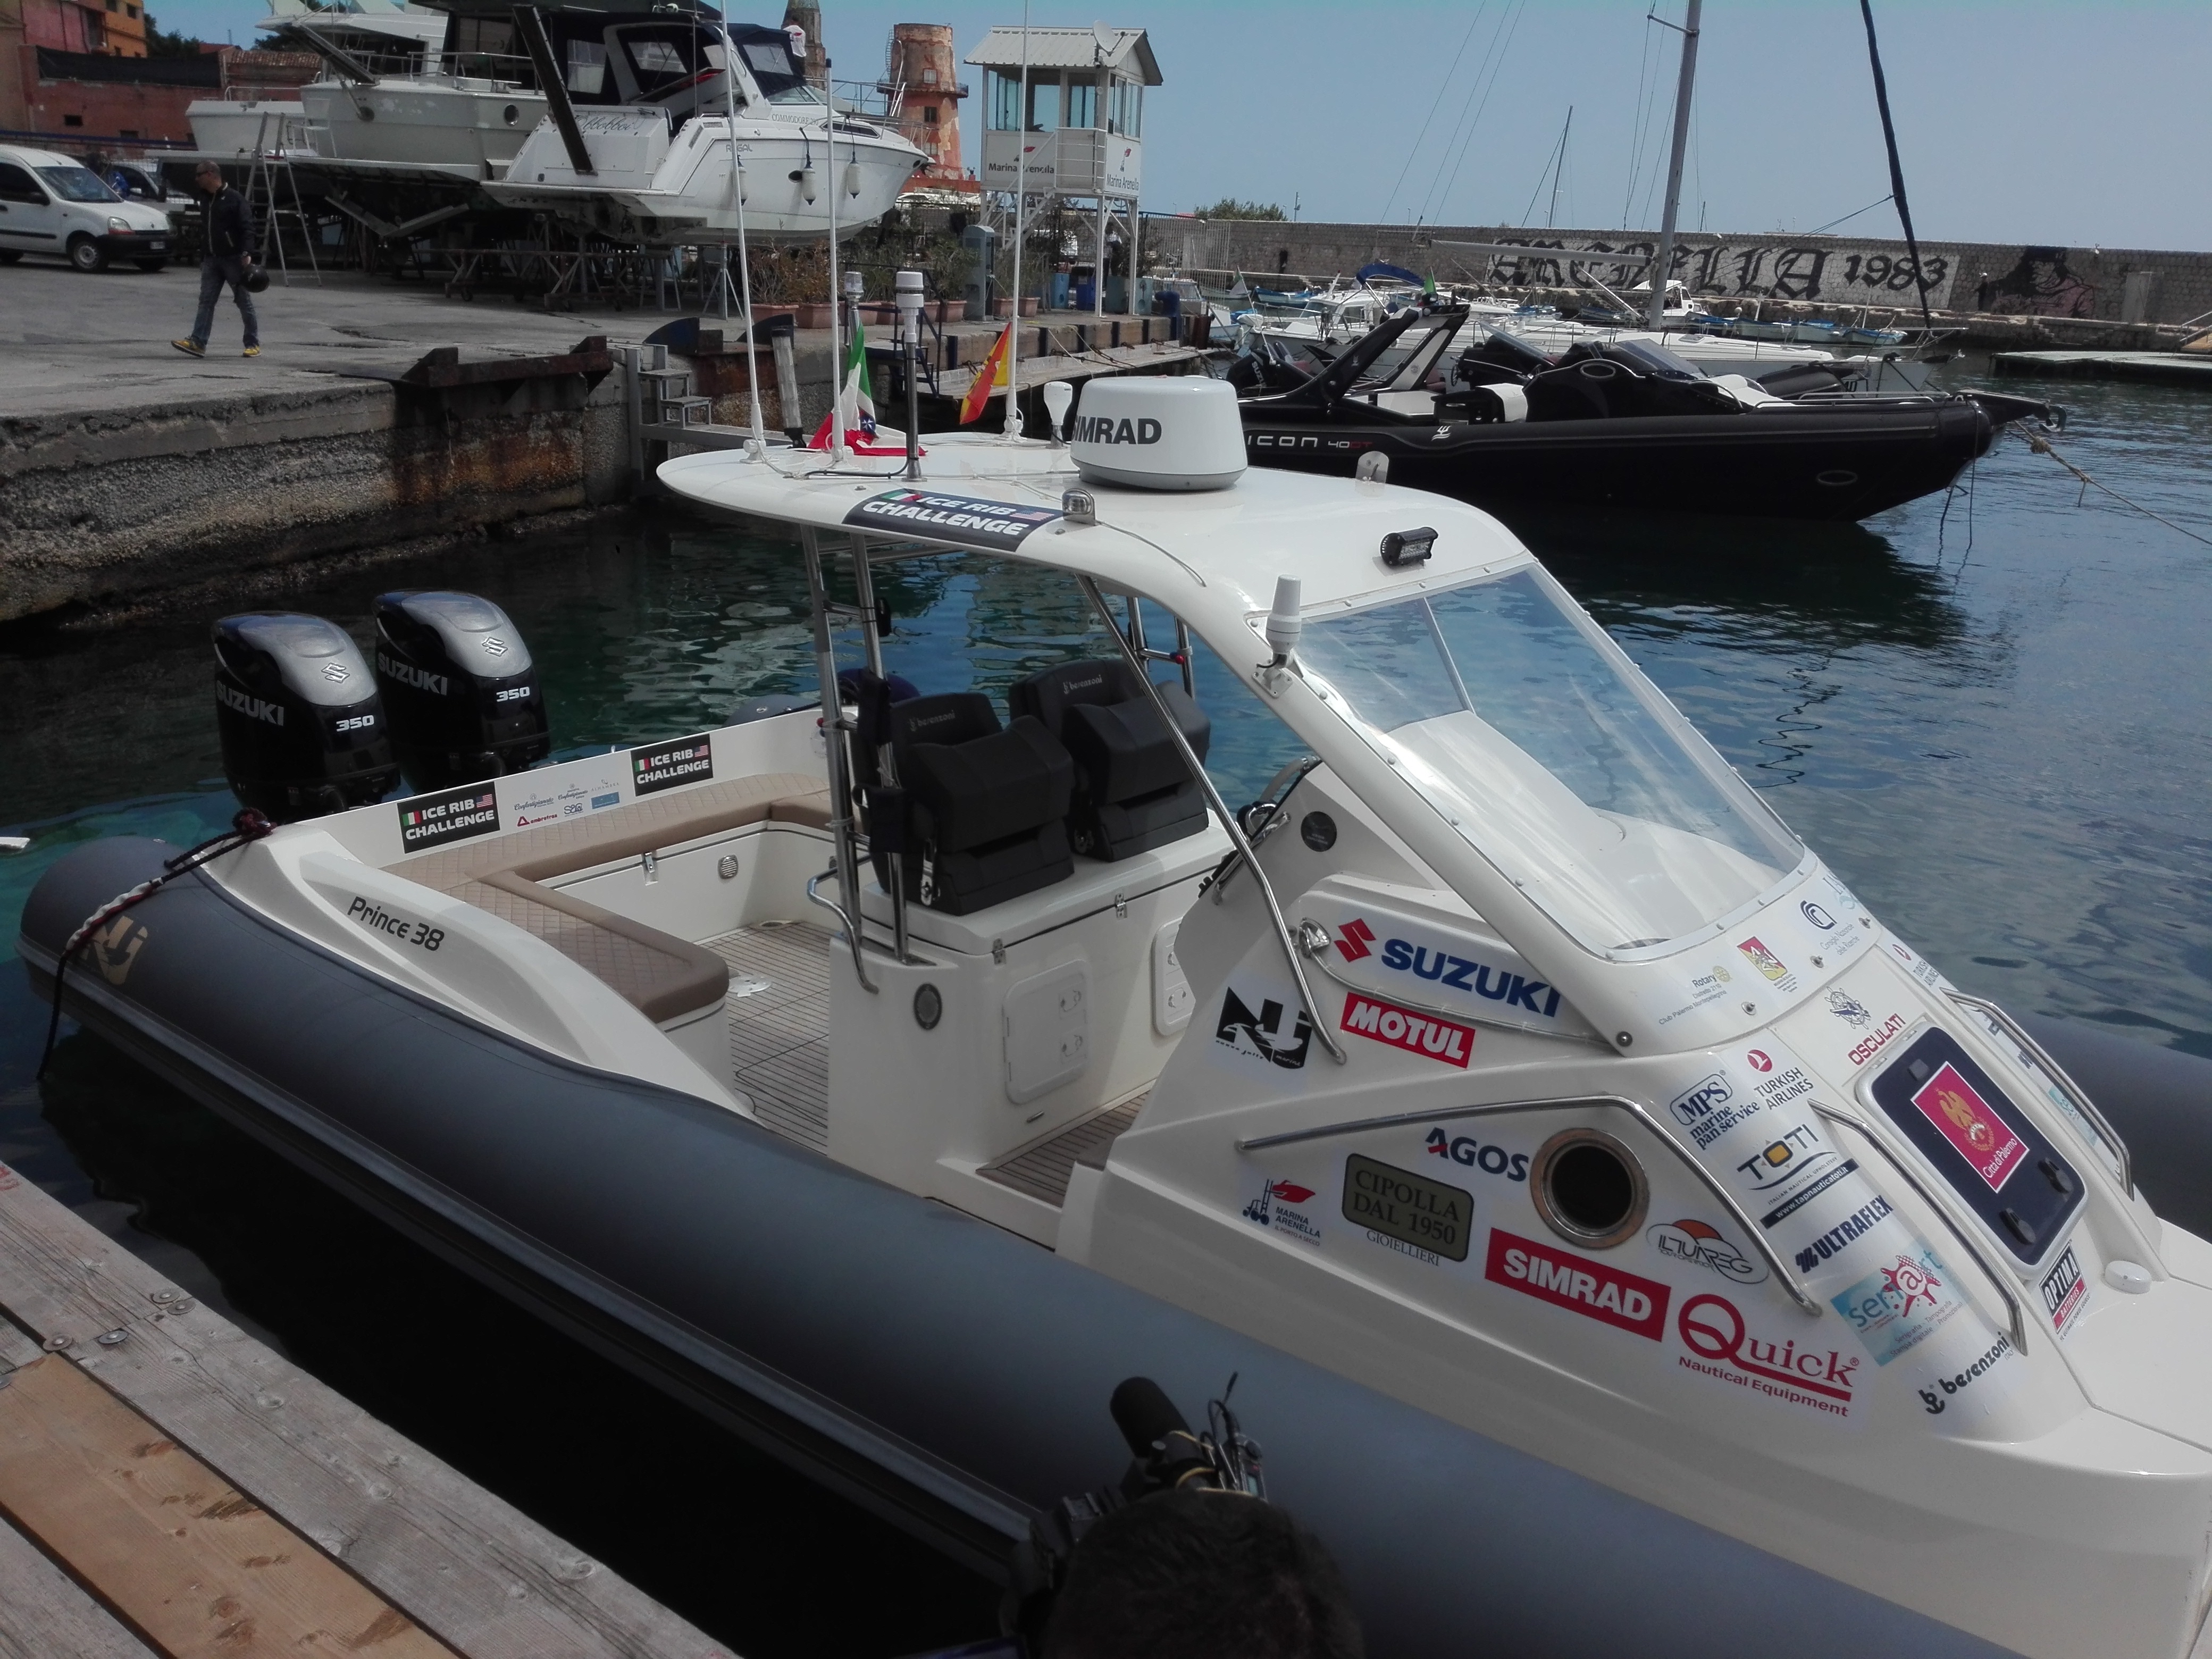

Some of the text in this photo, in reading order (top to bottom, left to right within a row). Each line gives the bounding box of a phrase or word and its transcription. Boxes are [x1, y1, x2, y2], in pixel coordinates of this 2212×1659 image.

[726, 144, 752, 153] RGAL
[988, 163, 1054, 174] Marina renella
[1107, 174, 1139, 191] Marina Arenella
[1844, 253, 1949, 296] 1983
[862, 500, 1030, 535] CHALLENGE
[916, 497, 1016, 515] ICE RIB
[378, 651, 448, 696] SUZUKI
[215, 679, 284, 727] SUZUKI
[496, 686, 531, 702] 350
[336, 715, 375, 732] 350
[636, 759, 710, 785] CHALLENGE
[651, 749, 693, 767] ICE RIB
[422, 799, 475, 820] ICE RIB
[514, 797, 554, 811] Confartigianato
[405, 810, 495, 841] CHALLENGE
[347, 896, 445, 951] Prince 38
[1380, 939, 1561, 1018] SUZUKI
[1691, 974, 1717, 988] Rotary
[1346, 1002, 1467, 1061] MOTUL
[1658, 1015, 1673, 1025] Club
[1672, 1005, 1694, 1018] Palermo
[1847, 1012, 1907, 1066] OSCULATI
[1678, 1079, 1729, 1119] MPS
[1754, 1067, 1804, 1099] TURKISH
[1765, 1078, 1815, 1111] AIRLINES
[1689, 1104, 1735, 1141] marine
[1696, 1101, 1760, 1151] pan service
[1426, 1127, 1529, 1183] AGOS
[1736, 1124, 1820, 1181] TOTI
[1993, 1153, 2003, 1166] di
[1996, 1138, 2018, 1164] Palermo
[1355, 1169, 1460, 1223] CIPOLLA
[1767, 1189, 1789, 1206] ITALIAN
[1788, 1173, 1813, 1191] NAUTICAL
[1775, 1166, 1849, 1219] www.tapnauticatoti.it
[1275, 1215, 1320, 1238] ARENELLA
[1276, 1206, 1309, 1225] MARINA
[1352, 1191, 1456, 1246] DAL 1950
[1814, 1194, 1894, 1259] ULTRAFLEX
[1280, 1226, 1298, 1238] PORTO
[1302, 1236, 1320, 1246] SECCO
[1366, 1229, 1440, 1267] GIOIELLIERI
[1503, 1247, 1652, 1322] SIMRAD
[2045, 1252, 2079, 1310] OPTIMA
[2060, 1286, 2080, 1319] BATTERIES
[1895, 1323, 1923, 1343] Serigrafia
[1924, 1300, 1953, 1323] Tampografia
[1890, 1341, 1913, 1358] Stampa
[1913, 1326, 1934, 1343] digitale
[1938, 1330, 2010, 1395] besenzoni
[1678, 1356, 1849, 1417] Nautical Equipment
